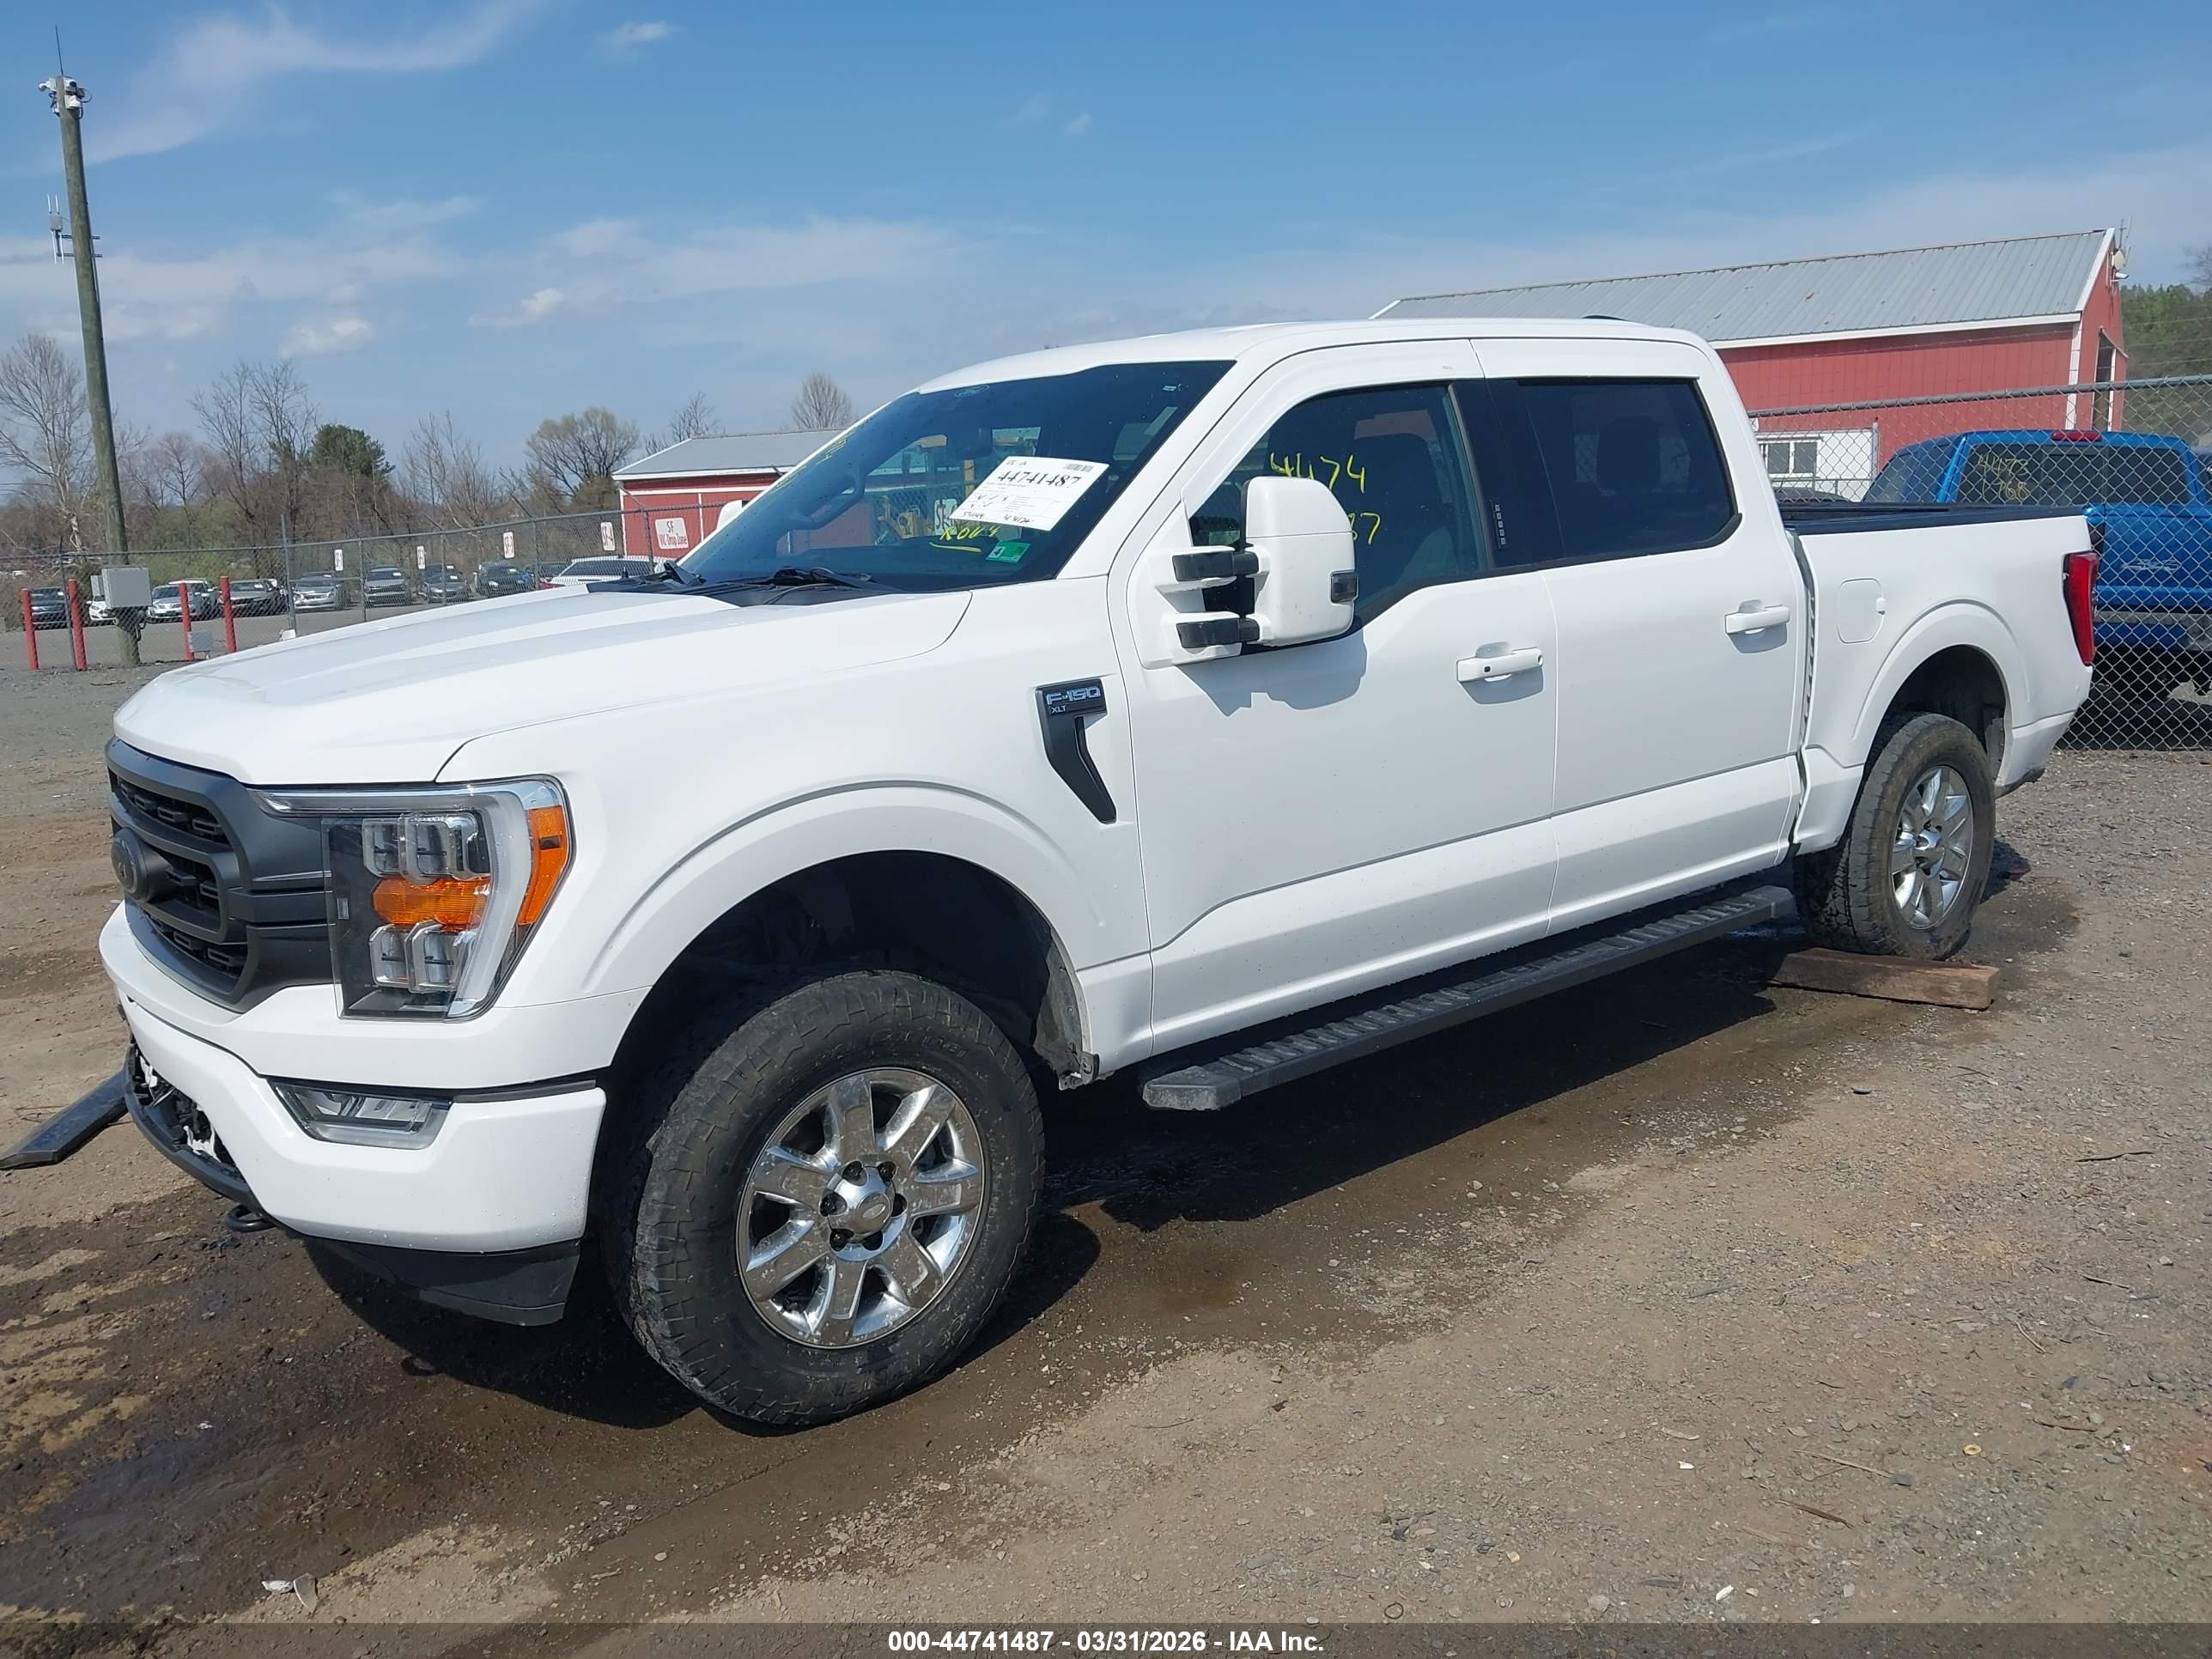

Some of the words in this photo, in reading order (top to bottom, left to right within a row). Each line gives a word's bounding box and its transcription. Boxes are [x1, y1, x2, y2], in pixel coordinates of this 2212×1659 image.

[998, 471, 1082, 489] 44741487
[666, 520, 674, 533] SF
[1046, 686, 1101, 705] F-150
[1050, 705, 1066, 714] XLT
